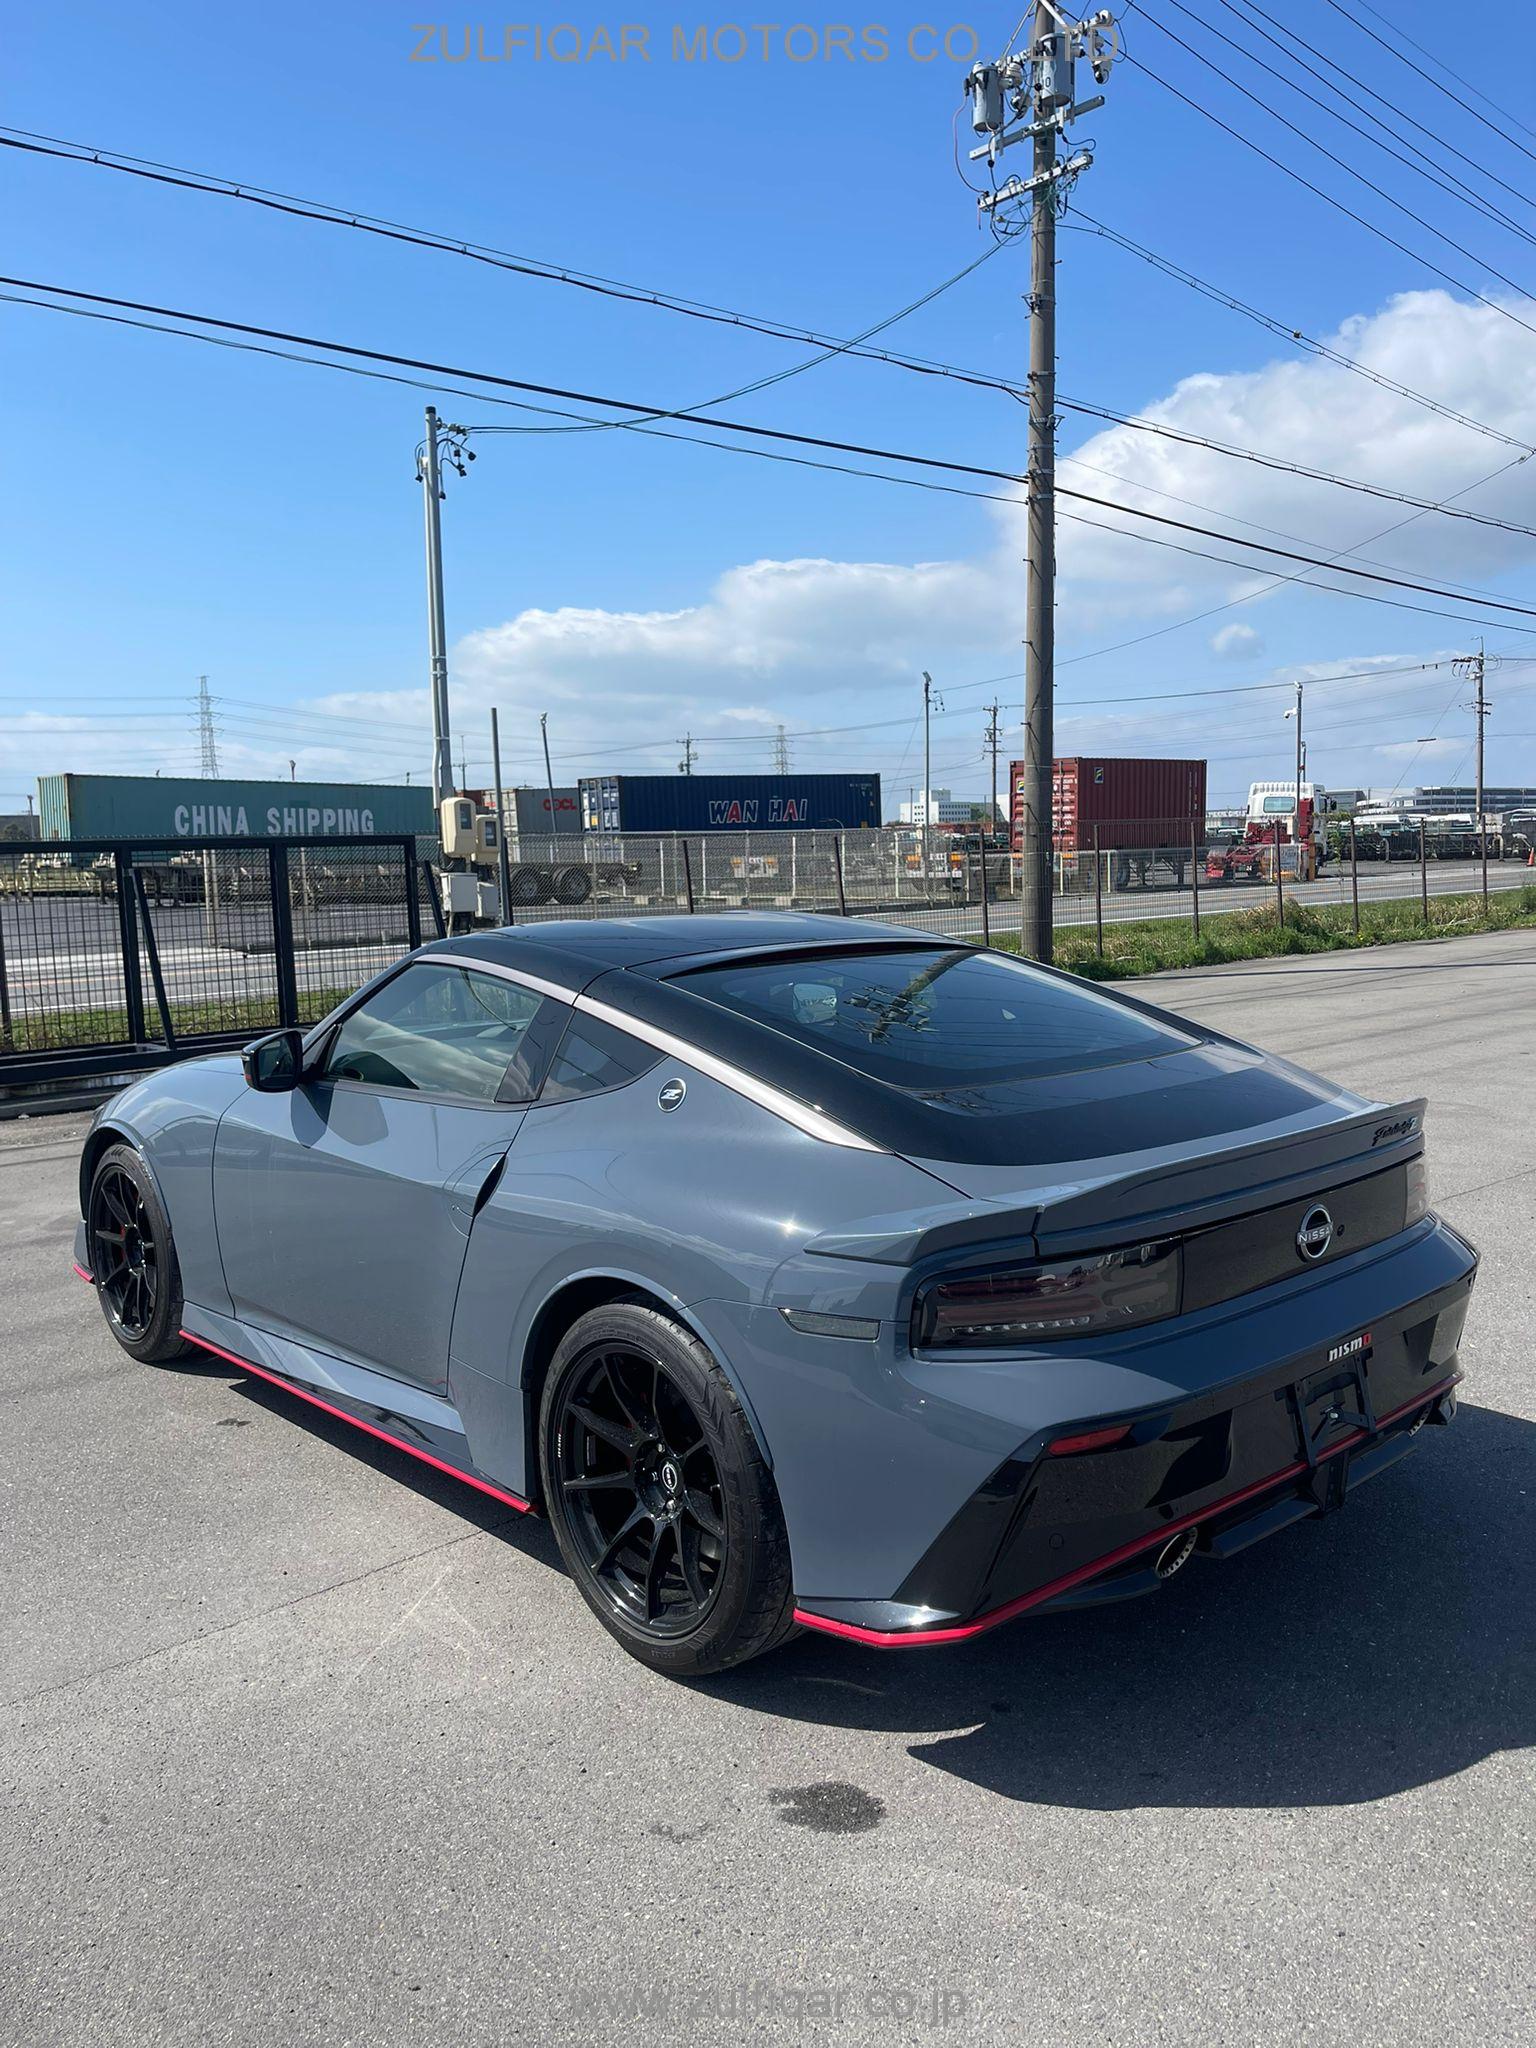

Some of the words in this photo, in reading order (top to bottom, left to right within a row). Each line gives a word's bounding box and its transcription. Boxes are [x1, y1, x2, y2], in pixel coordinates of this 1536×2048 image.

[174, 804, 250, 836] CHINA
[266, 807, 374, 836] SHIPPING
[709, 800, 758, 824] WAN
[768, 799, 808, 822] HAI
[1299, 1225, 1332, 1244] NISSA
